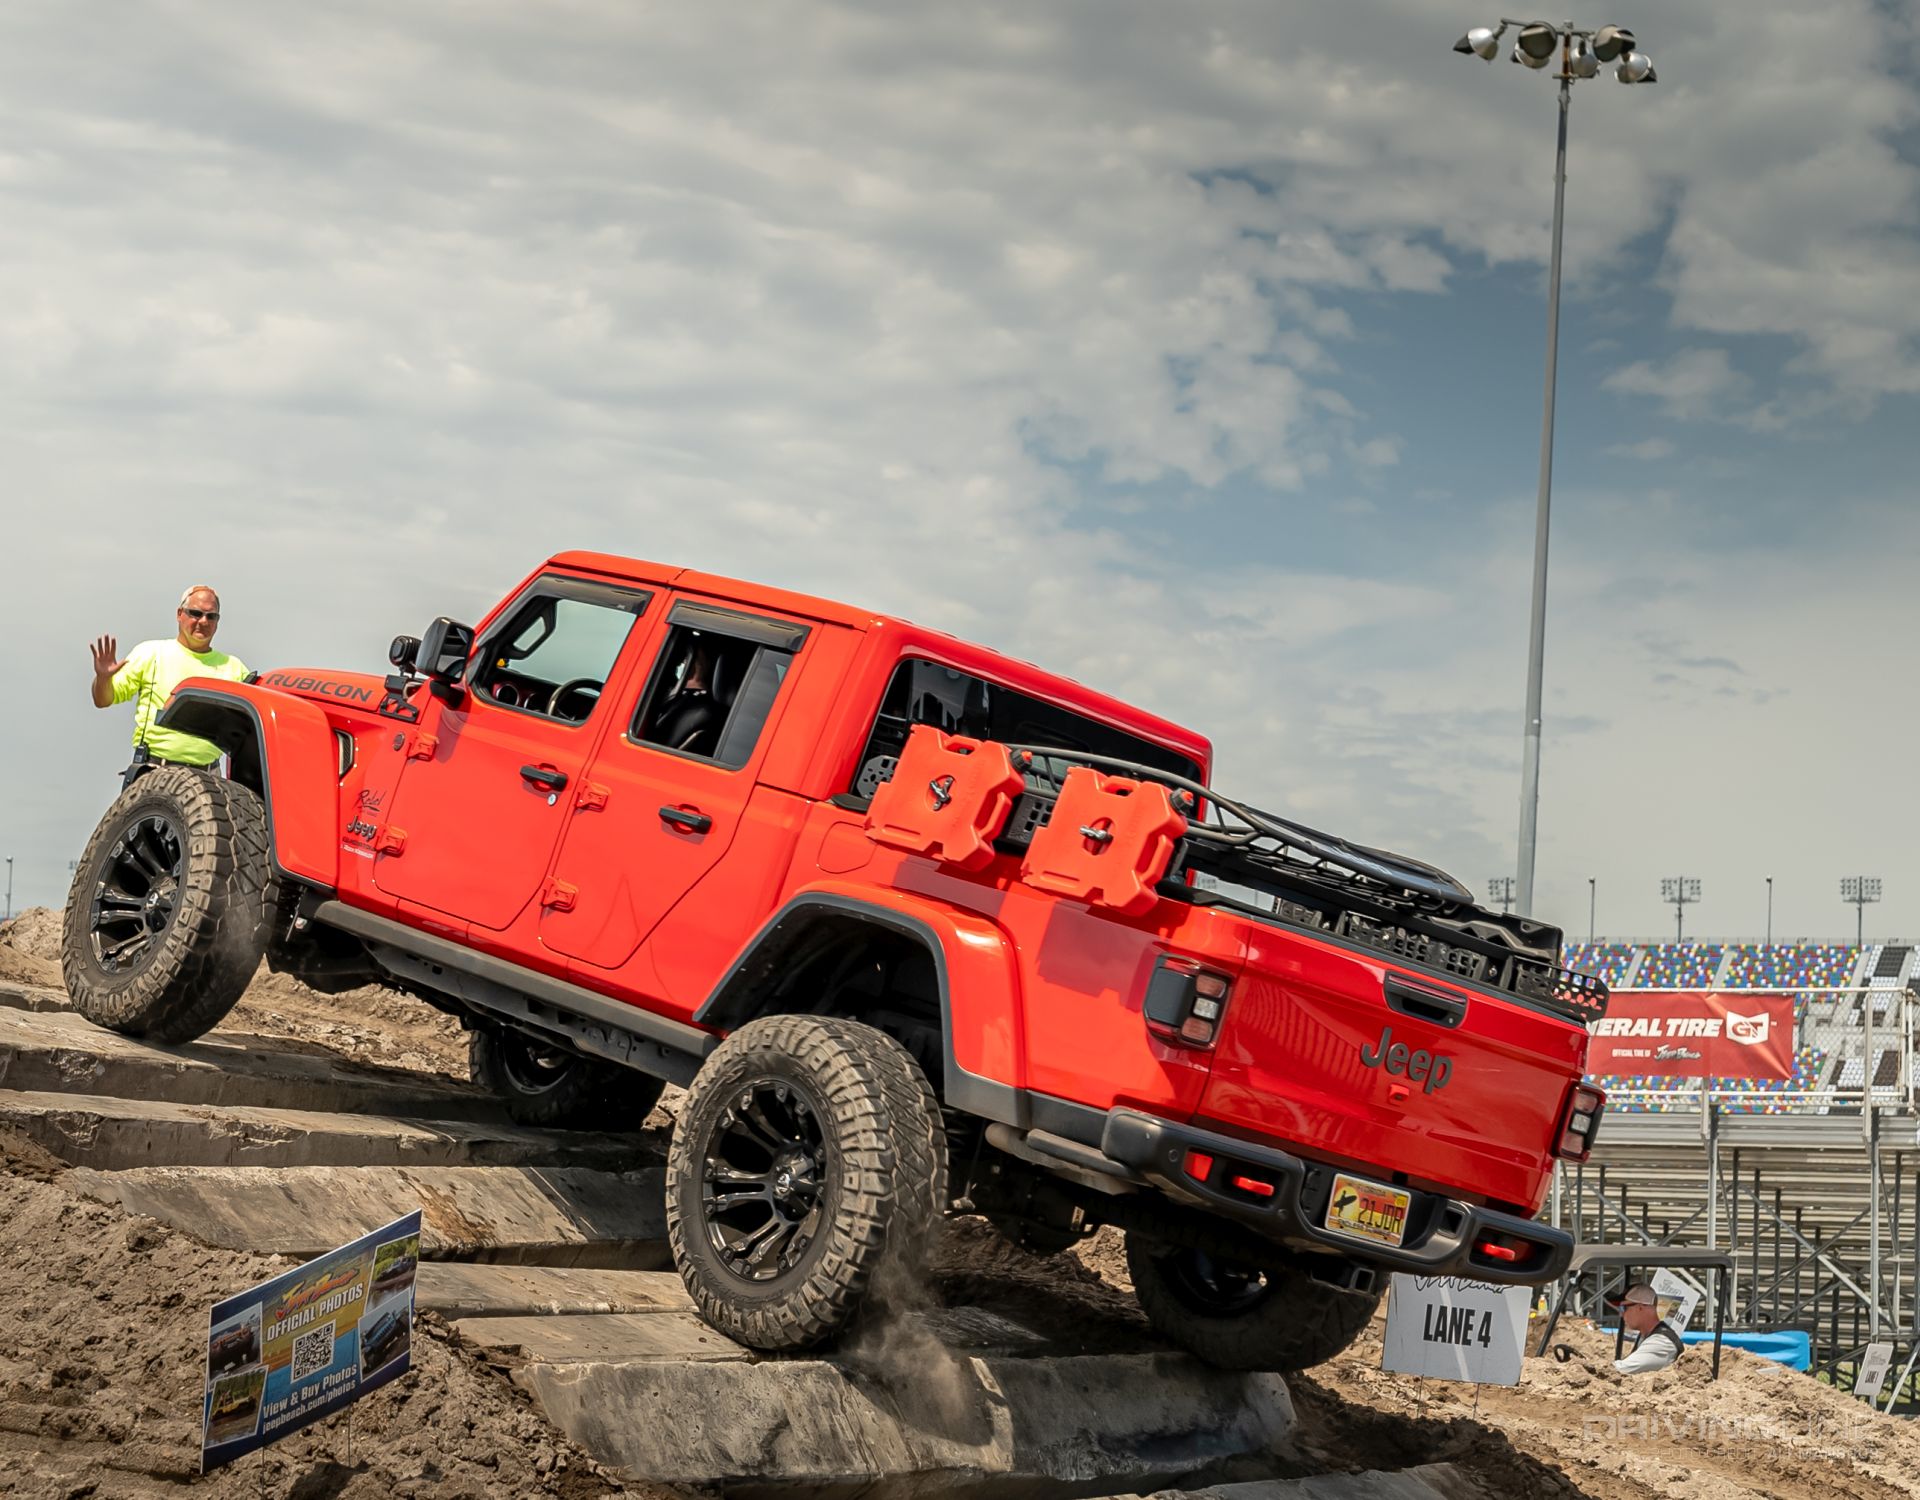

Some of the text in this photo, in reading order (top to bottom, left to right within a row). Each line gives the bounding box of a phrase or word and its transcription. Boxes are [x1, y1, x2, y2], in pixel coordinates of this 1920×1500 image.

[266, 673, 373, 703] RUBICON
[347, 815, 377, 842] Jeep
[1586, 1018, 1663, 1037] NERAL
[1666, 1018, 1724, 1037] TIRE
[1361, 1026, 1454, 1095] Jeep
[267, 1282, 364, 1341] OFFICIAL PHOTOS
[1423, 1303, 1493, 1349] LANE 4
[263, 1363, 358, 1419] View & Buy Photos
[263, 1380, 357, 1436] jeepbeach.com/photos
